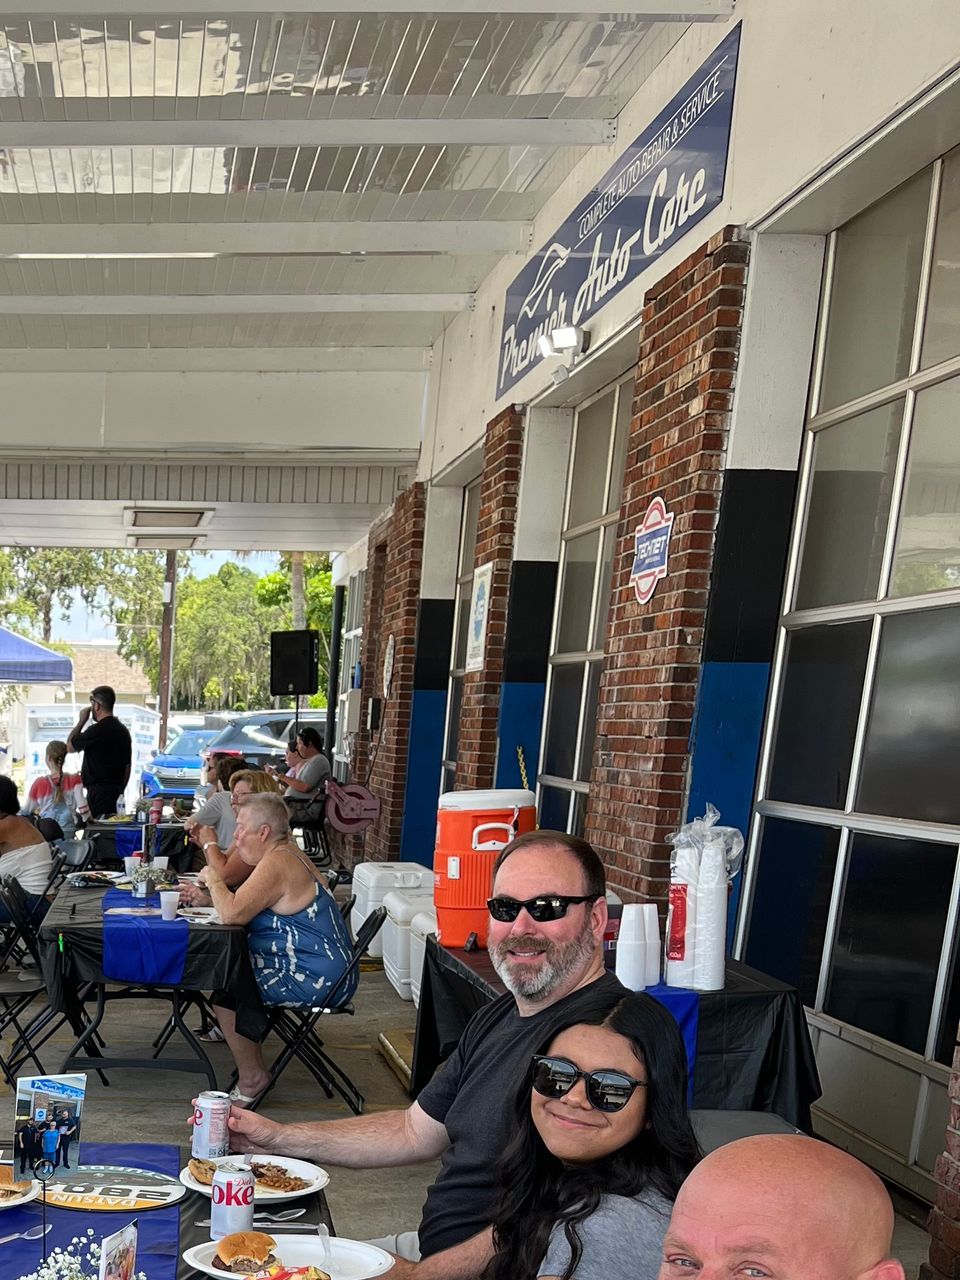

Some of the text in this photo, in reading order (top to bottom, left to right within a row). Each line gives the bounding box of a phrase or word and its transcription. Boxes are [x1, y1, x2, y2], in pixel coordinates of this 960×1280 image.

[579, 71, 721, 239] COMPLETE AUTO REPAIR & SERVICE
[572, 228, 641, 325] Auto
[643, 168, 707, 255] Care
[40, 1183, 172, 1201] 280
[52, 1194, 137, 1207] DATSUN
[212, 1181, 255, 1206] oke
